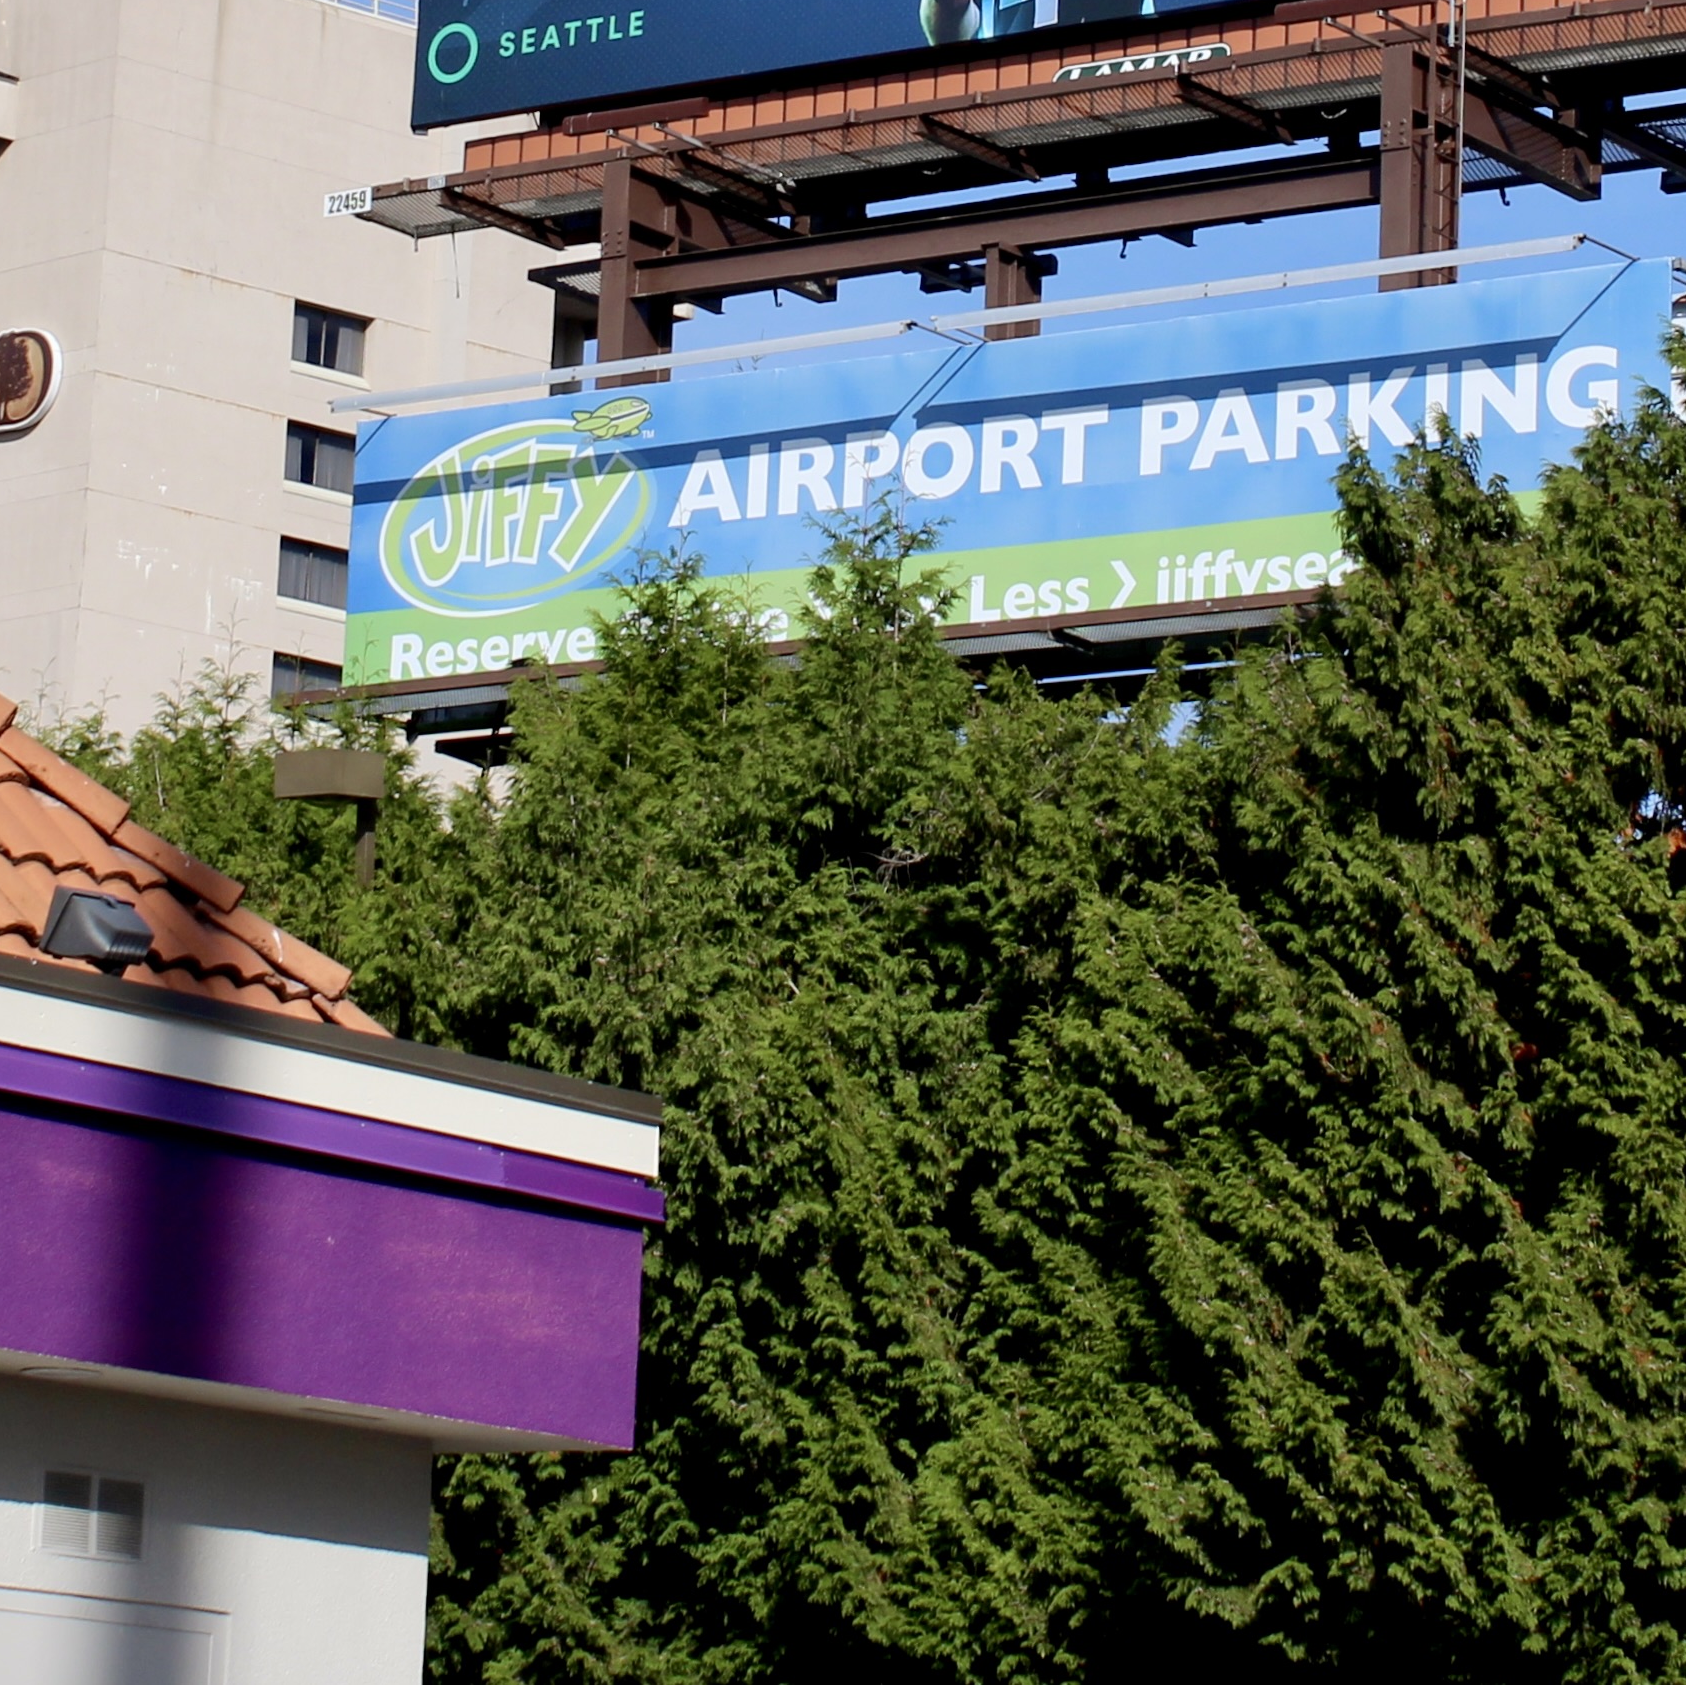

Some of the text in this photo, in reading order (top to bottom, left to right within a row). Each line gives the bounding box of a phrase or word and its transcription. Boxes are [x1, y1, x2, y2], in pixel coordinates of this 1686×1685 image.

[499, 10, 645, 57] SEATTLE
[327, 190, 367, 214] 22459
[668, 344, 1618, 528] AIRPORT PARKING
[389, 626, 596, 681] Reserve
[968, 573, 1090, 623] Less
